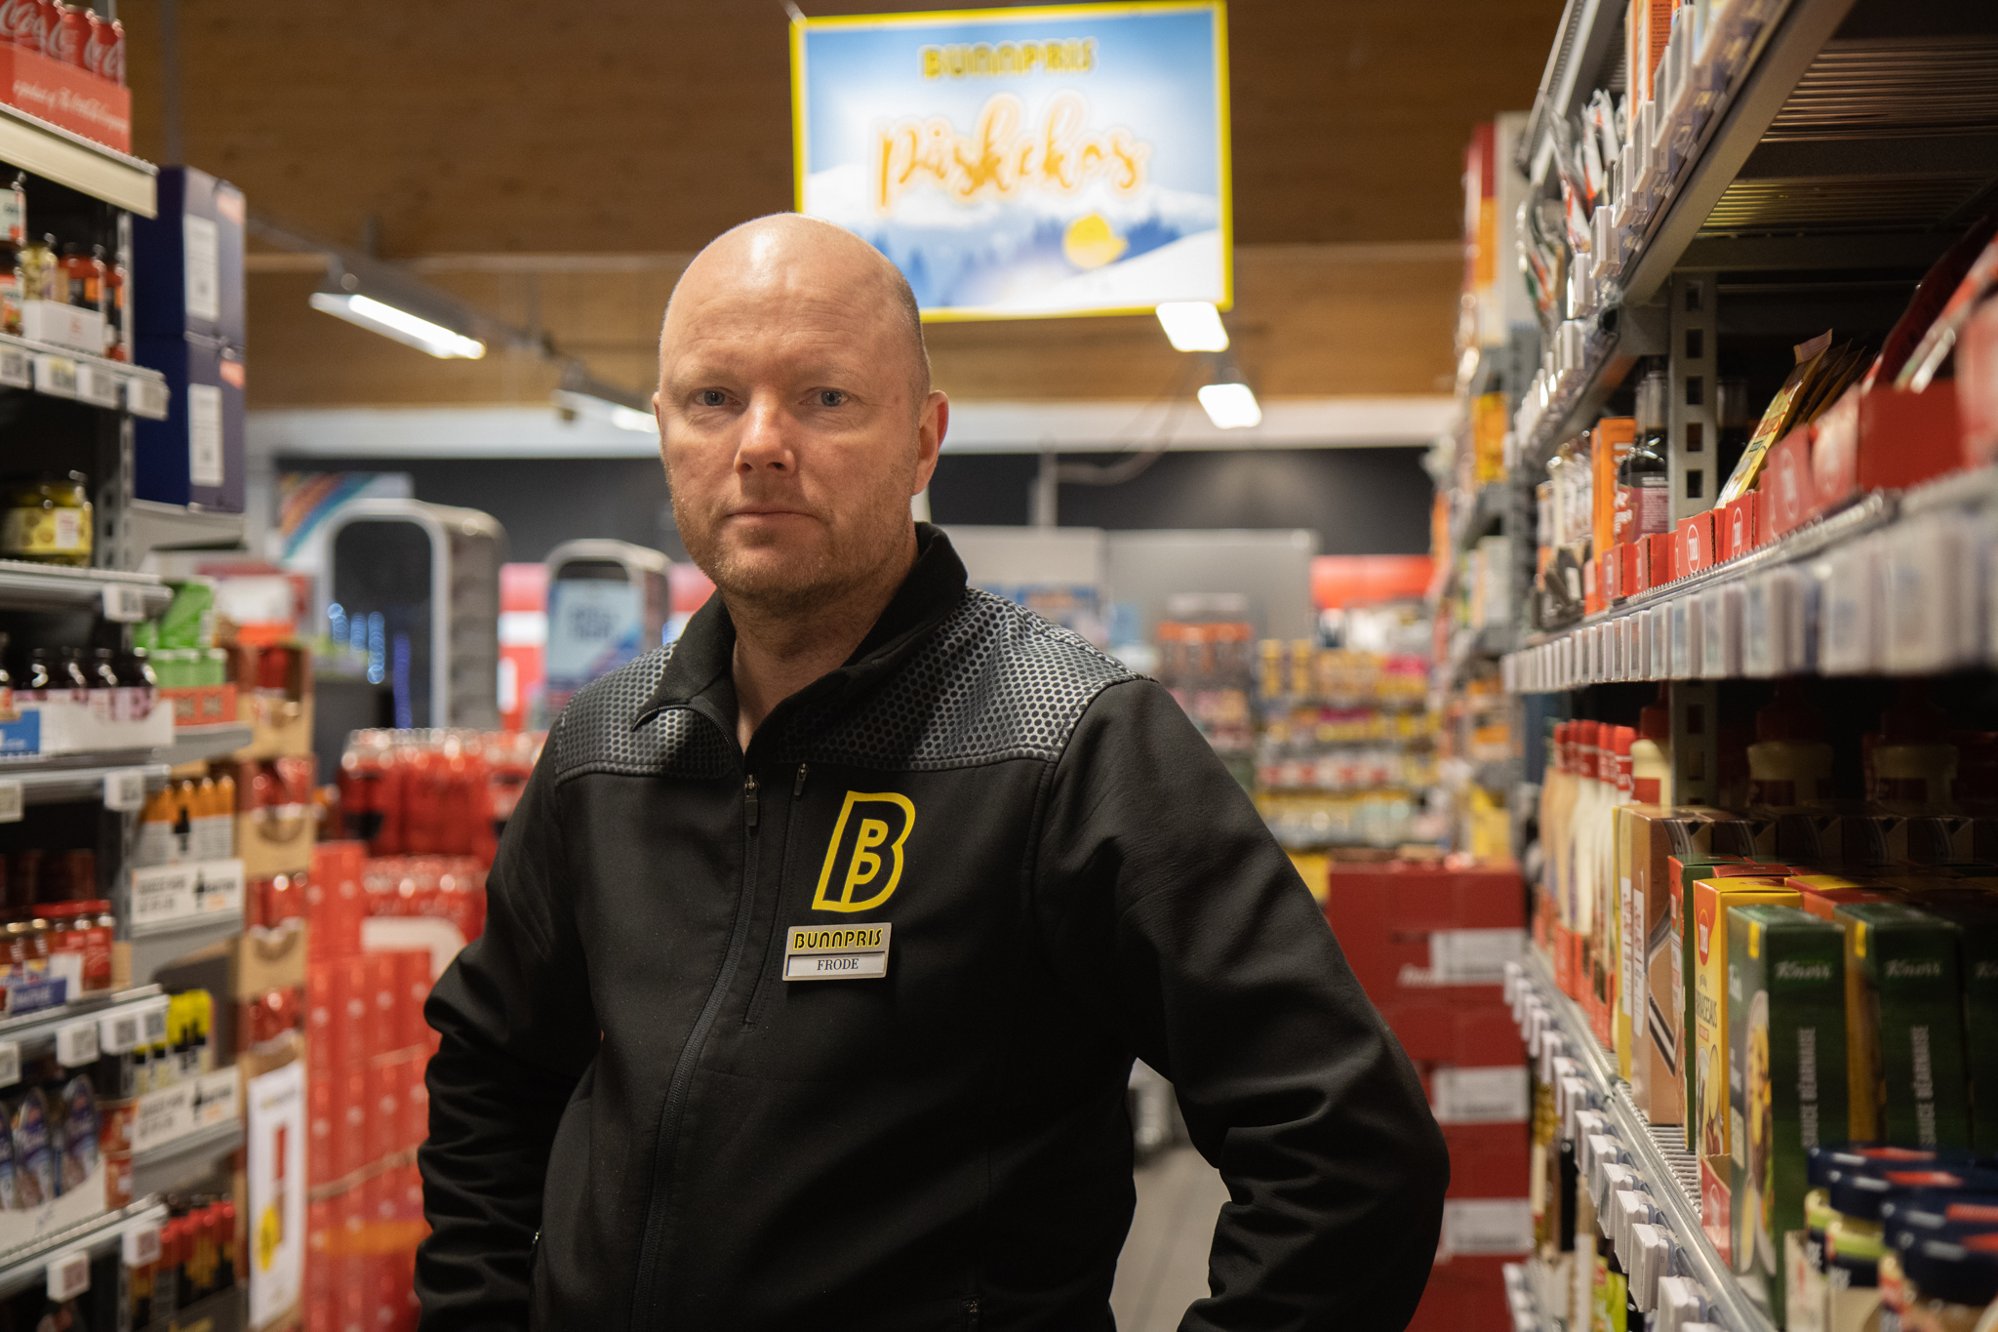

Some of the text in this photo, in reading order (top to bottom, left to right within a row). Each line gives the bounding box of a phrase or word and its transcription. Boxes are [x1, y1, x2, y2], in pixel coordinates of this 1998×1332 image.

[923, 40, 1091, 78] BUNNPRIS
[793, 928, 883, 950] BUNNPRIS
[817, 958, 860, 971] FRODE
